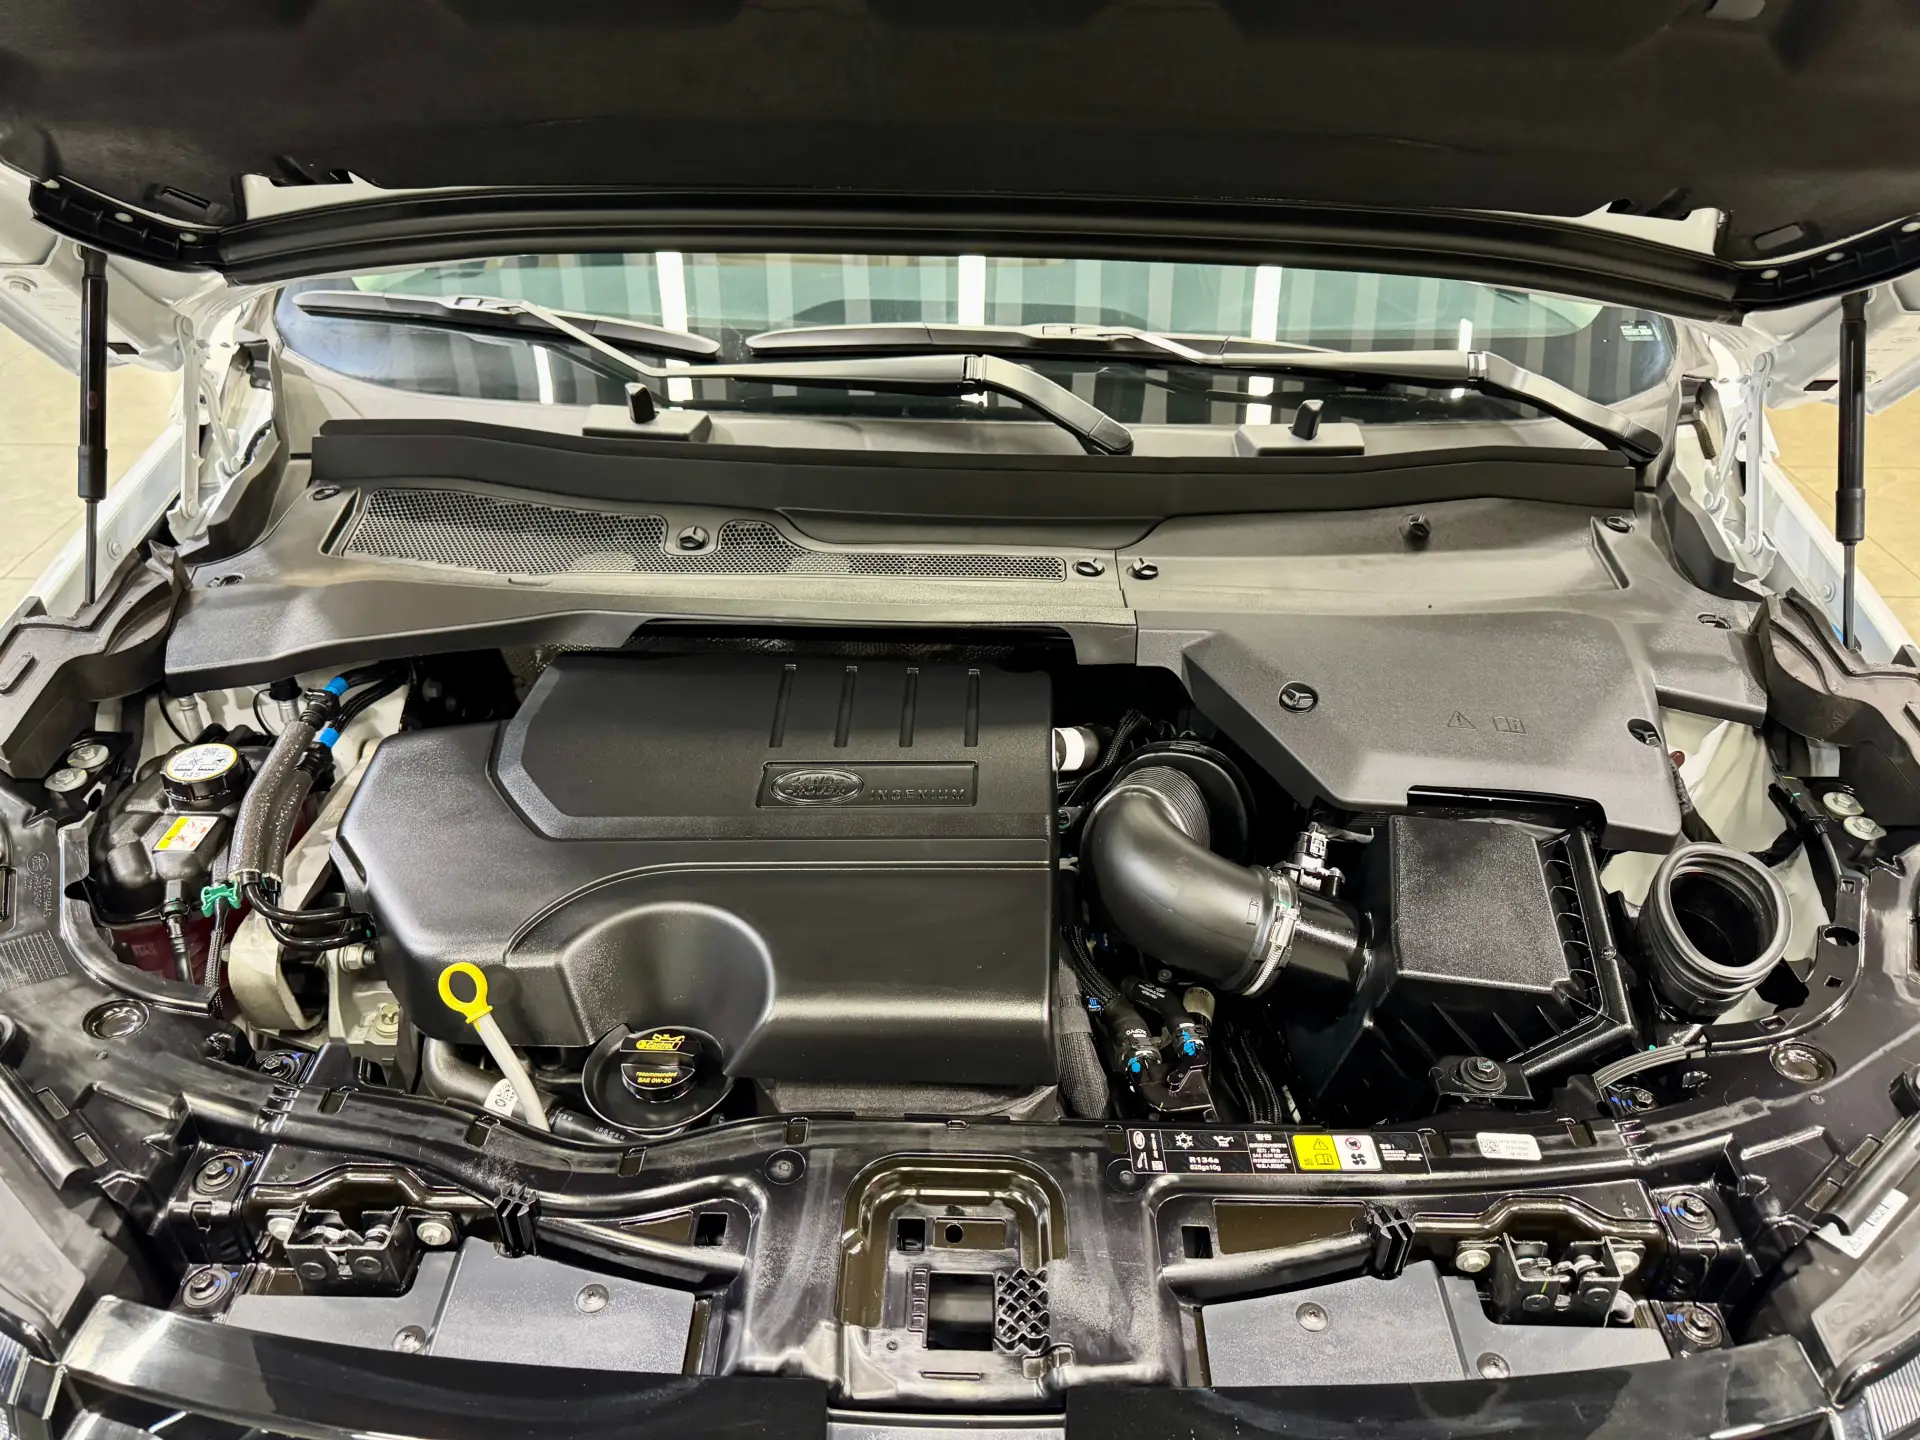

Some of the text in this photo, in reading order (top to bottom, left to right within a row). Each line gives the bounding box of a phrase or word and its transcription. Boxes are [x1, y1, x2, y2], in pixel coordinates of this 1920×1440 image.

[869, 789, 965, 801] INGENIUM
[646, 1041, 675, 1050] Castrol
[1188, 1156, 1220, 1164] R134a
